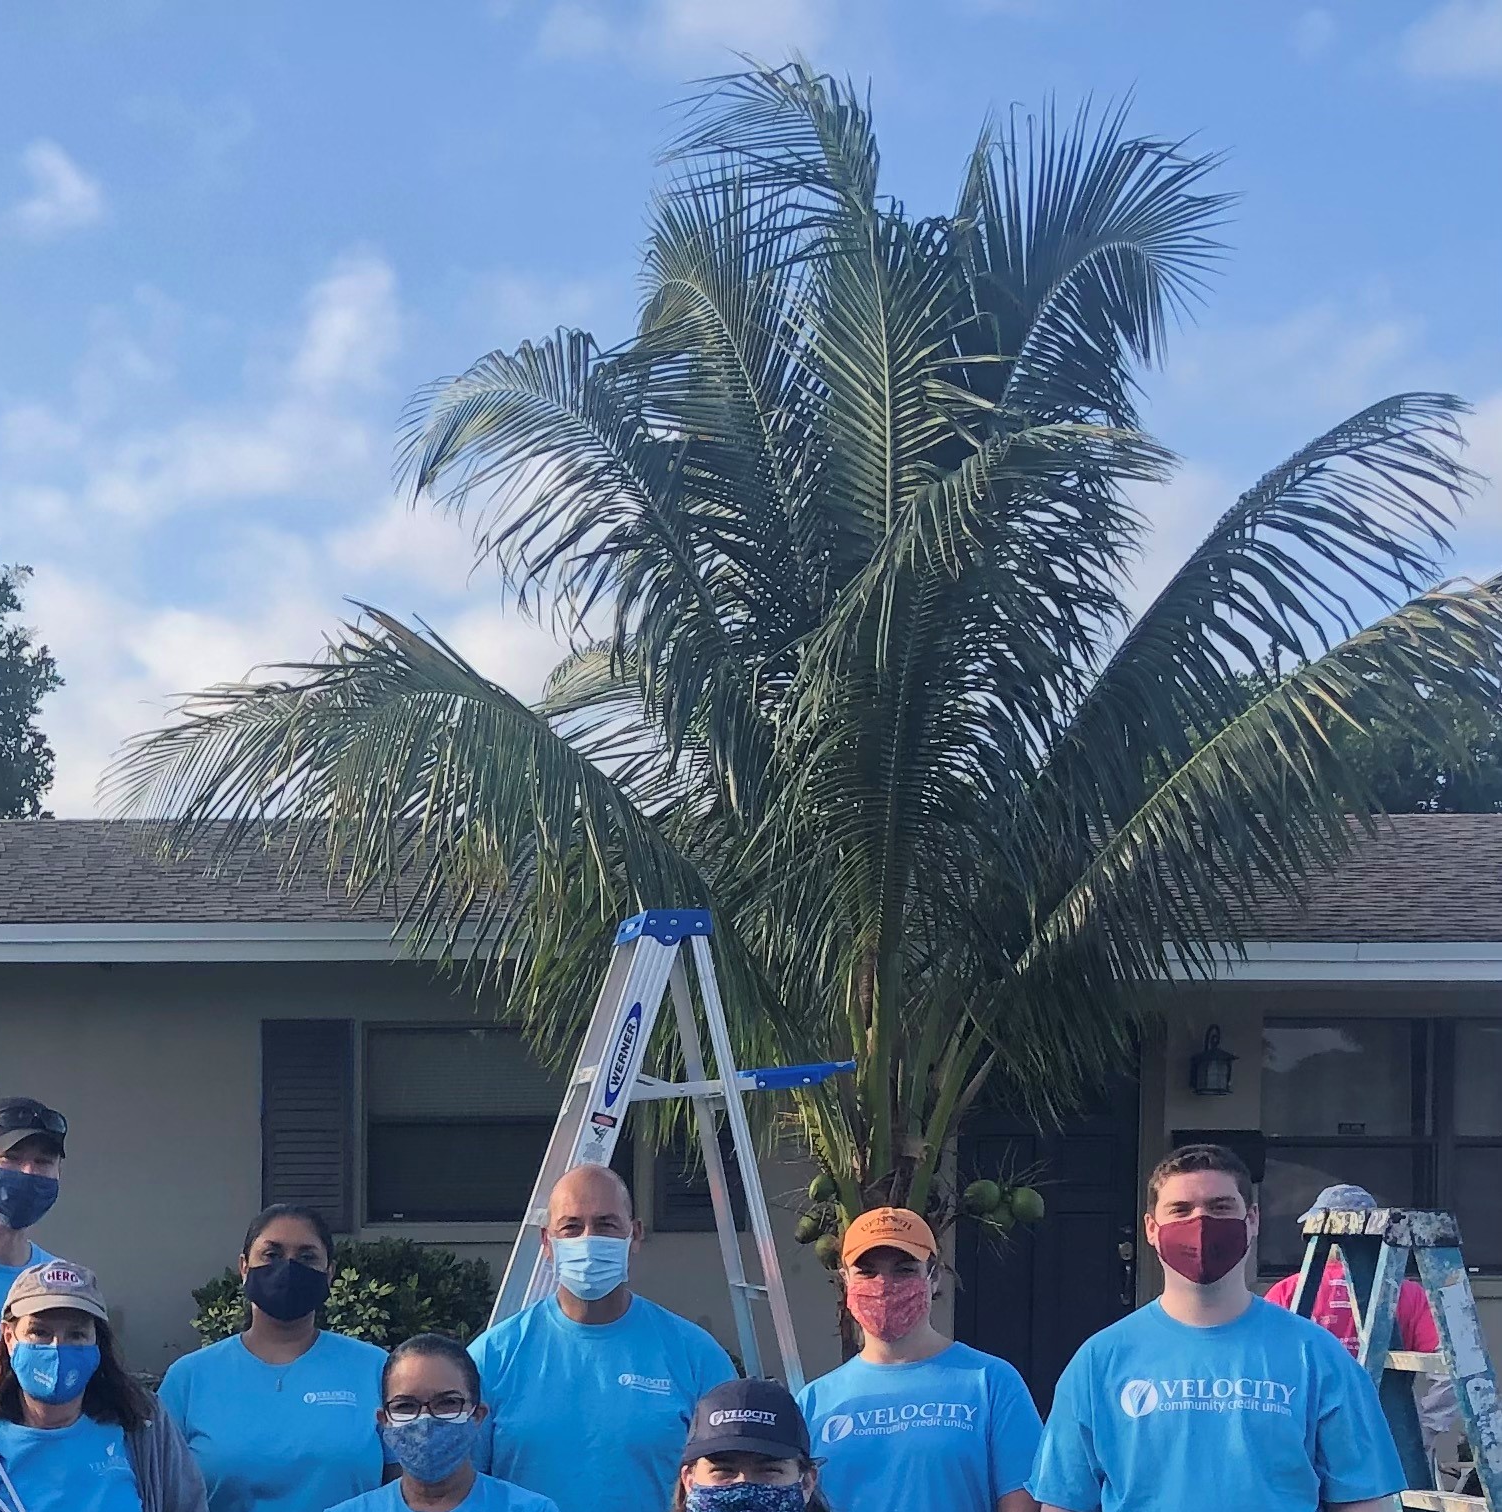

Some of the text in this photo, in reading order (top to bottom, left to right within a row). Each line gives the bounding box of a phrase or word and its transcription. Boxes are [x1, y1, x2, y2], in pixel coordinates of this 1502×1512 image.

[610, 1021, 637, 1086] WERNER
[1160, 1378, 1296, 1405] VELOCITY
[724, 1409, 777, 1421] VELOCITY
[857, 1402, 977, 1426] VELOCITY
[1159, 1398, 1292, 1416] community credit union
[854, 1417, 974, 1436] community credit union
